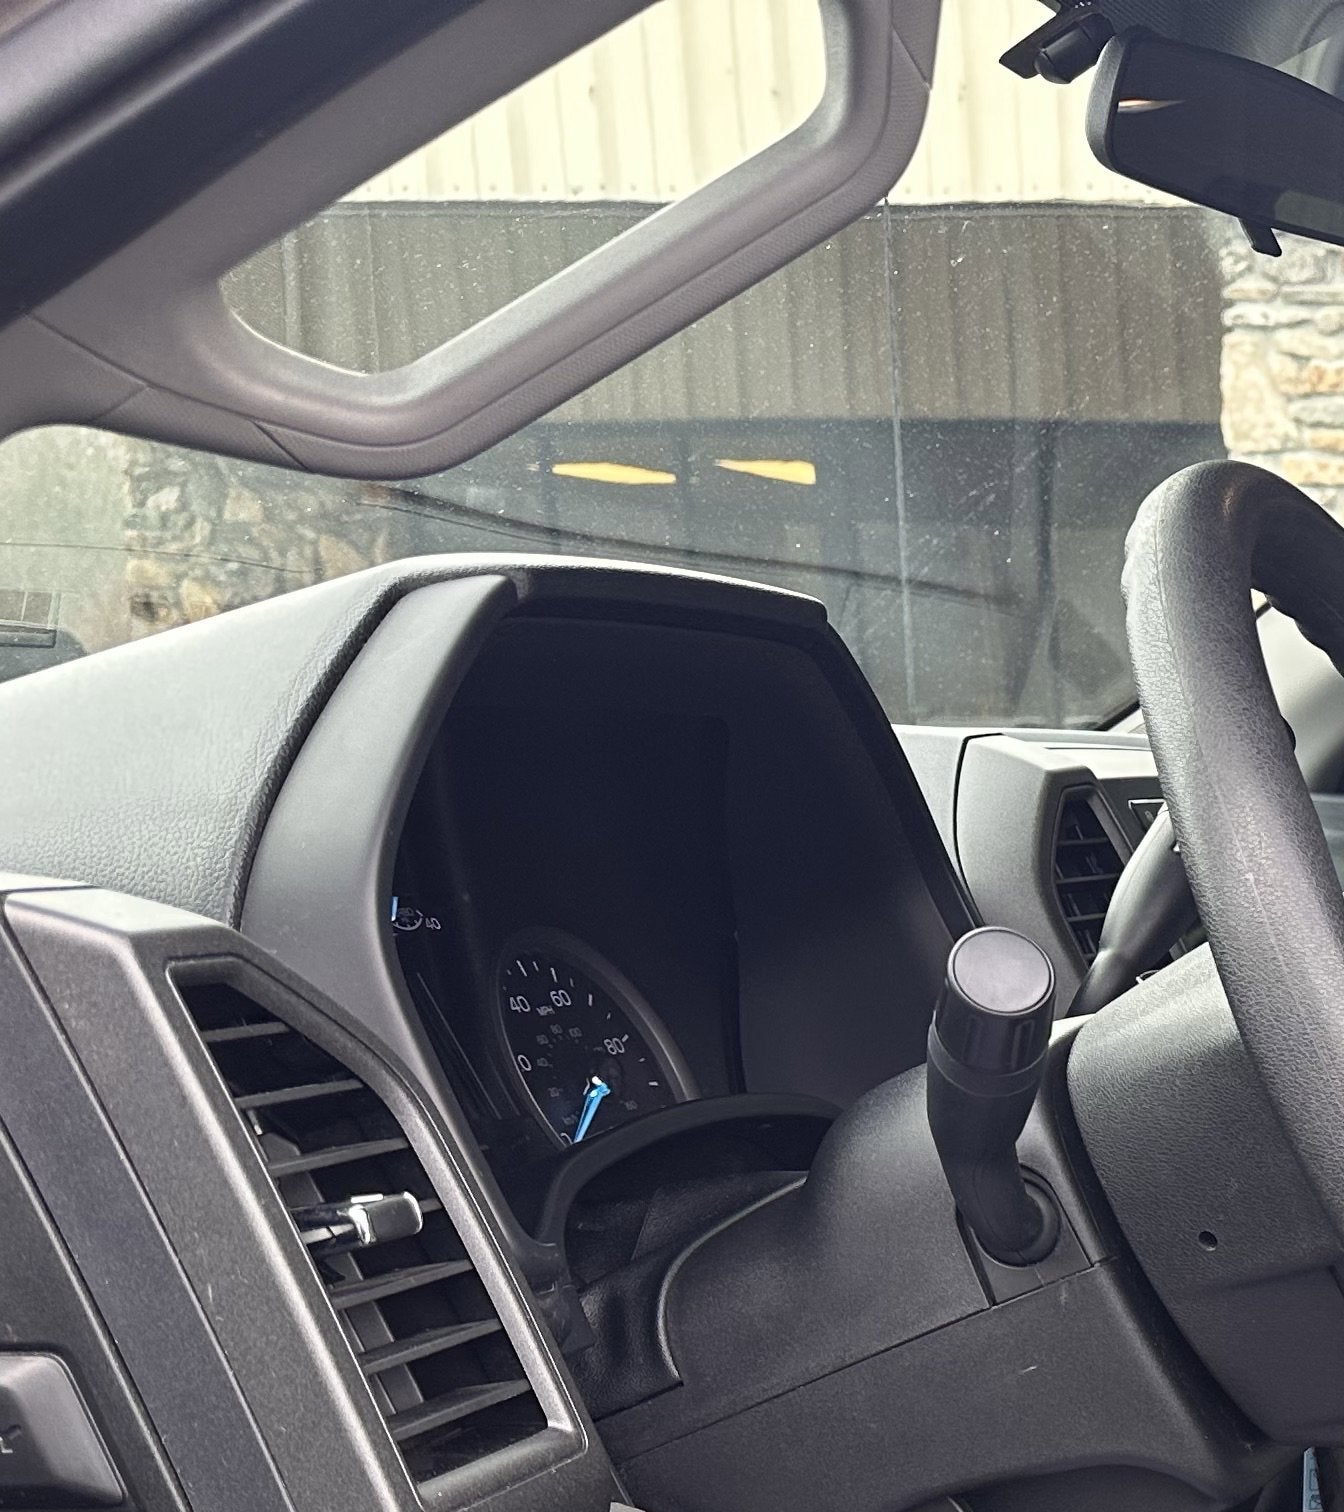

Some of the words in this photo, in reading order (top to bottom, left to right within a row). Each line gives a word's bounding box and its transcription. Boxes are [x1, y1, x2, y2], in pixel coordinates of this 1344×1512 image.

[509, 995, 531, 1013] 40
[550, 989, 572, 1007] 60
[604, 1037, 625, 1055] 80
